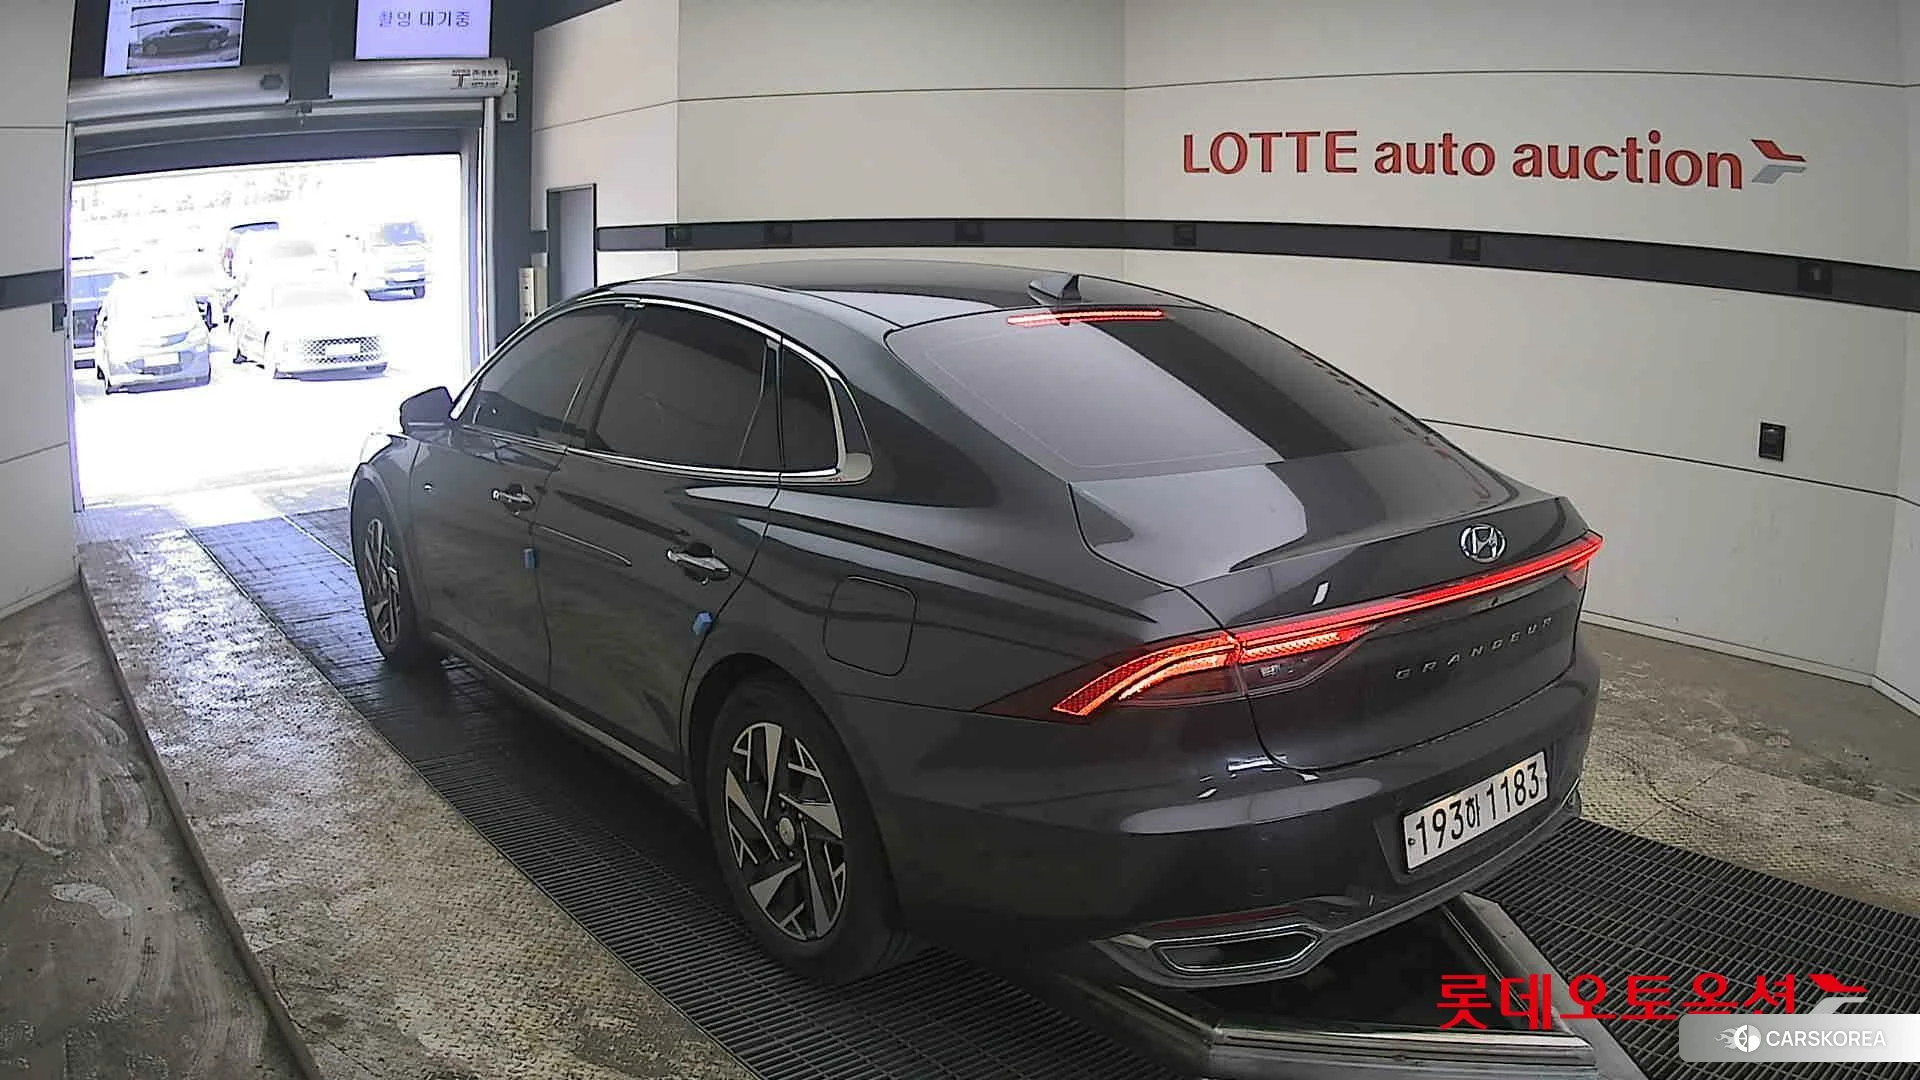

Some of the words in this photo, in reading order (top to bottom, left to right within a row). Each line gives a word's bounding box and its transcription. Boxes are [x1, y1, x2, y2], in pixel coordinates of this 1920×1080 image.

[419, 11, 470, 28] 대기중
[1183, 130, 1358, 175] LOTTE
[1374, 132, 1496, 177] auto
[1511, 130, 1743, 190] auction
[1394, 616, 1553, 681] GRANDEUR
[1415, 793, 1481, 856] 193하
[1486, 761, 1540, 821] 1183
